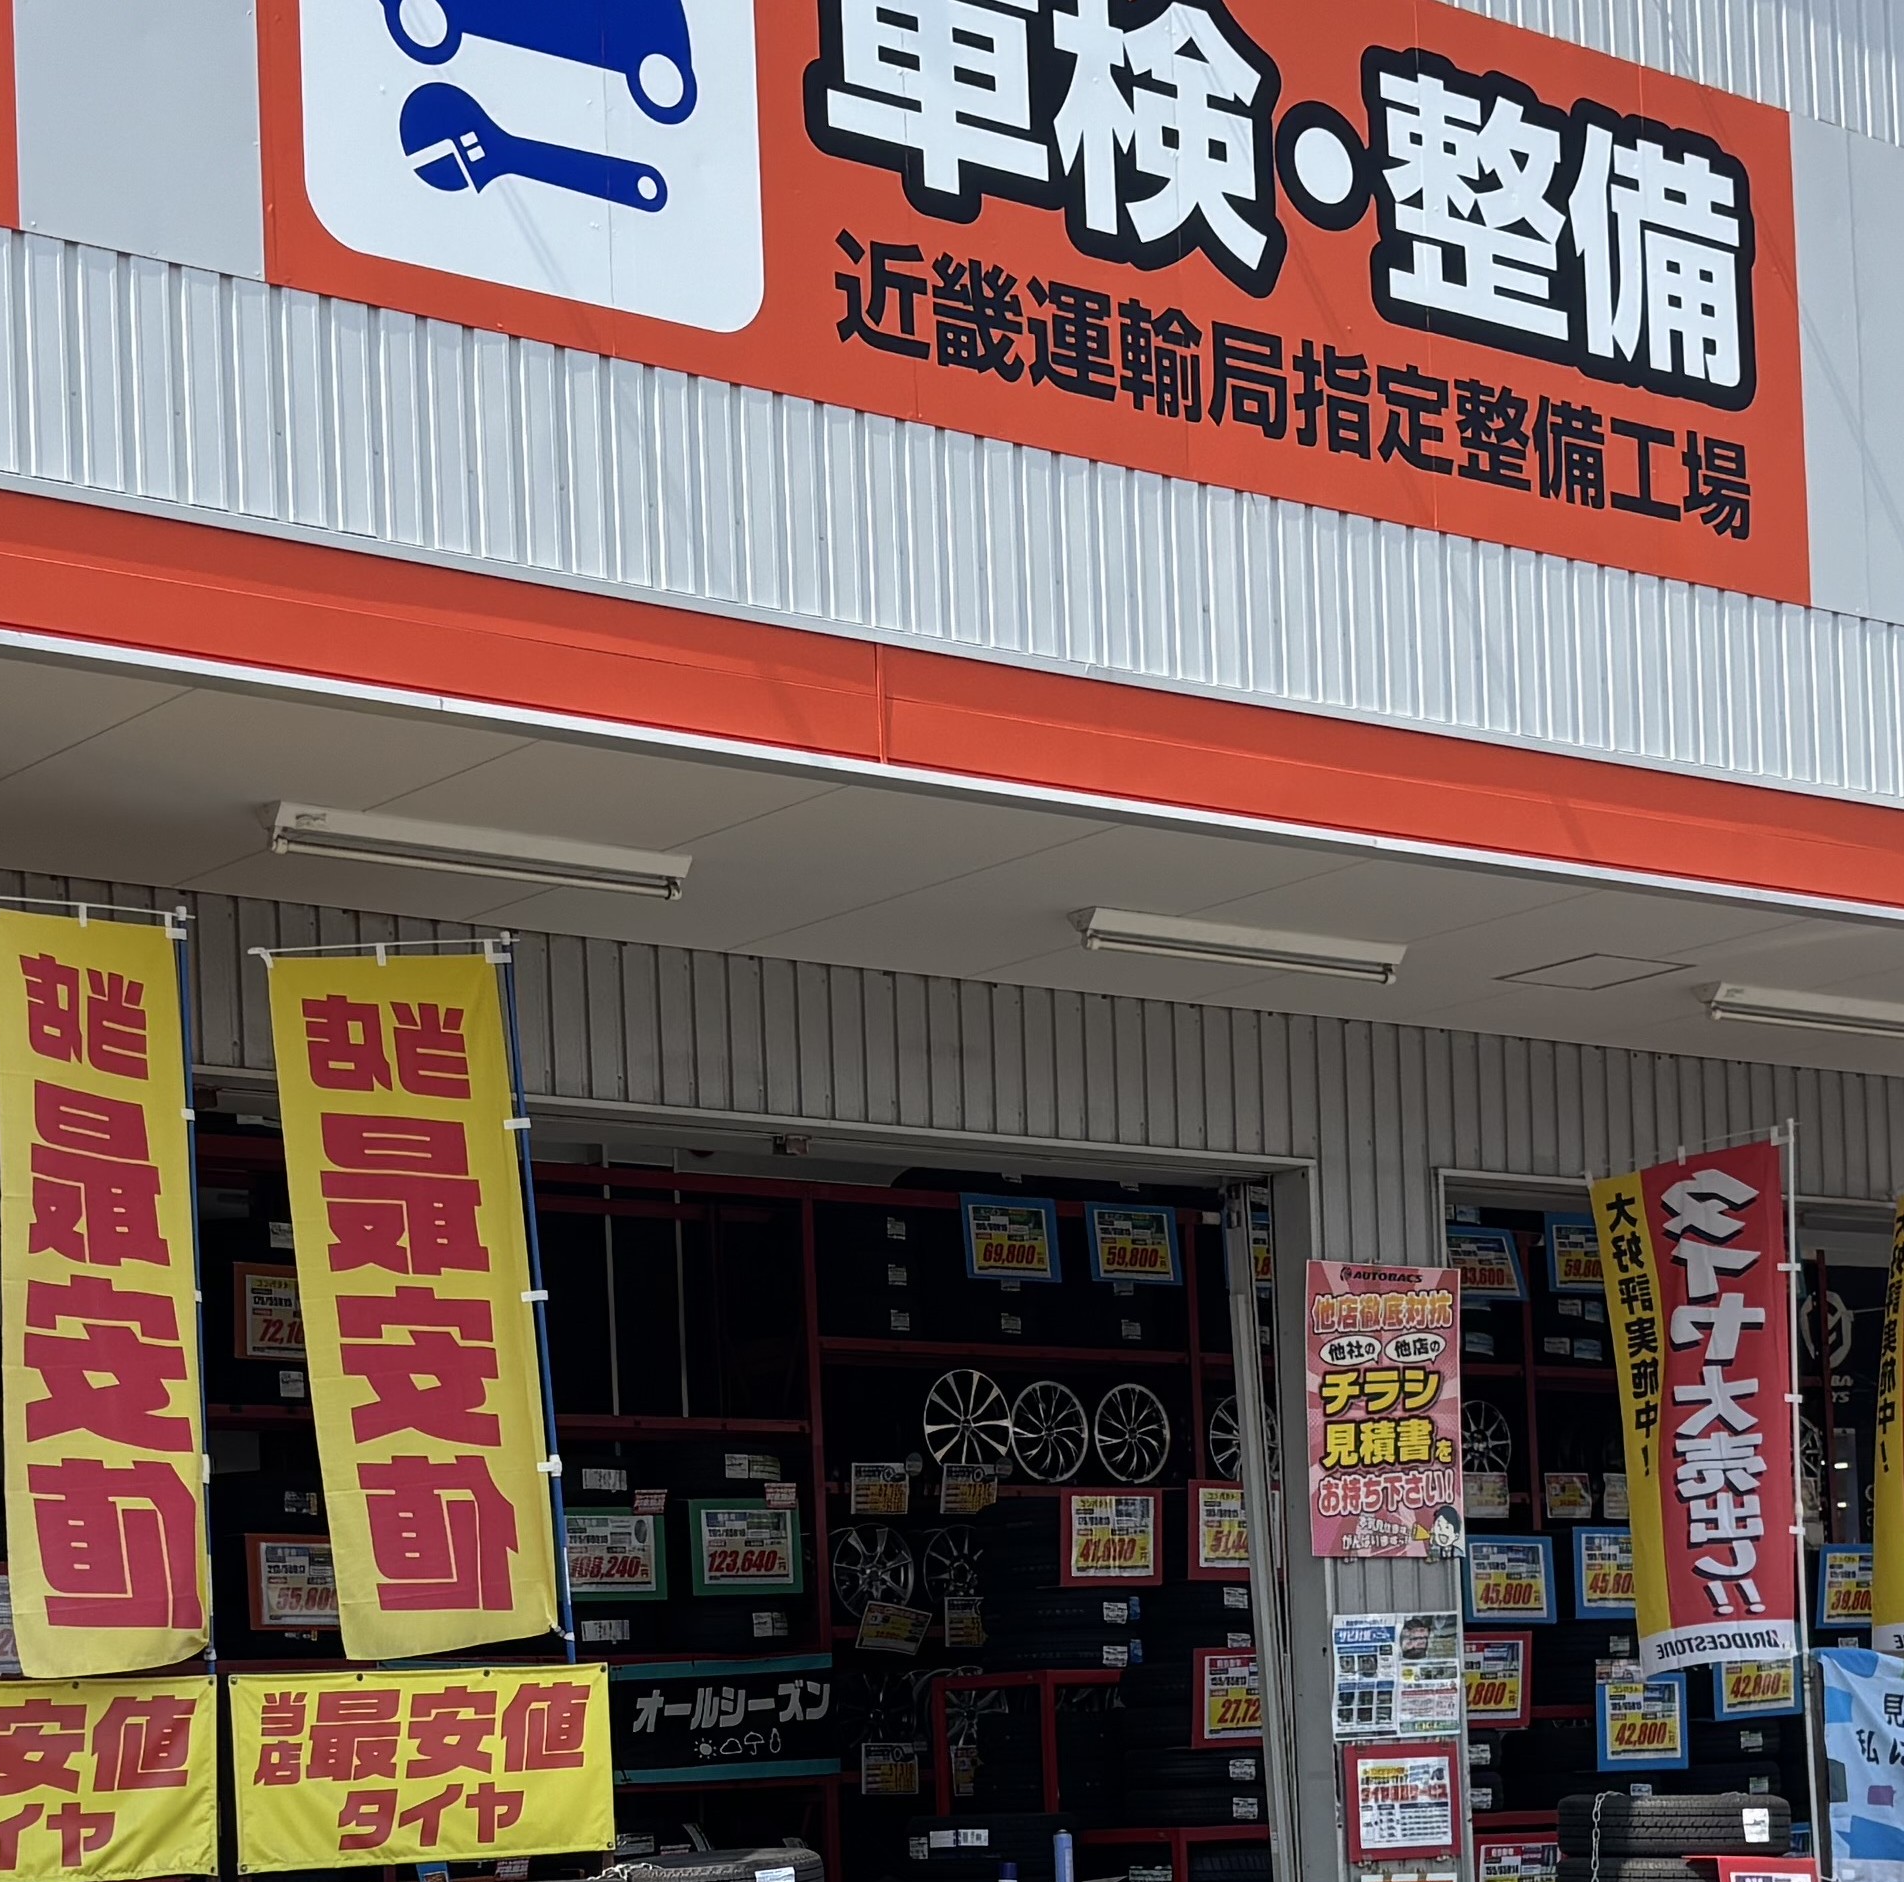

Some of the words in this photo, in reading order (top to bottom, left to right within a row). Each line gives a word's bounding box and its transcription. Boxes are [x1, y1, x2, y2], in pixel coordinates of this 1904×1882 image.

[804, 0, 1756, 410] 車検・整備
[834, 232, 1754, 541] 近畿運輸局指定整備工場
[1353, 1270, 1423, 1284] AUTOBACS
[1328, 1340, 1376, 1361] 他社の
[1395, 1338, 1441, 1357] 他店の
[1321, 1367, 1440, 1418] チラシ
[1322, 1420, 1453, 1469] 見積書を
[708, 1550, 777, 1573] 123,640
[303, 1680, 591, 1783] 最安値
[632, 1679, 832, 1732] オールシーズン
[335, 1785, 527, 1852] タイヤ
